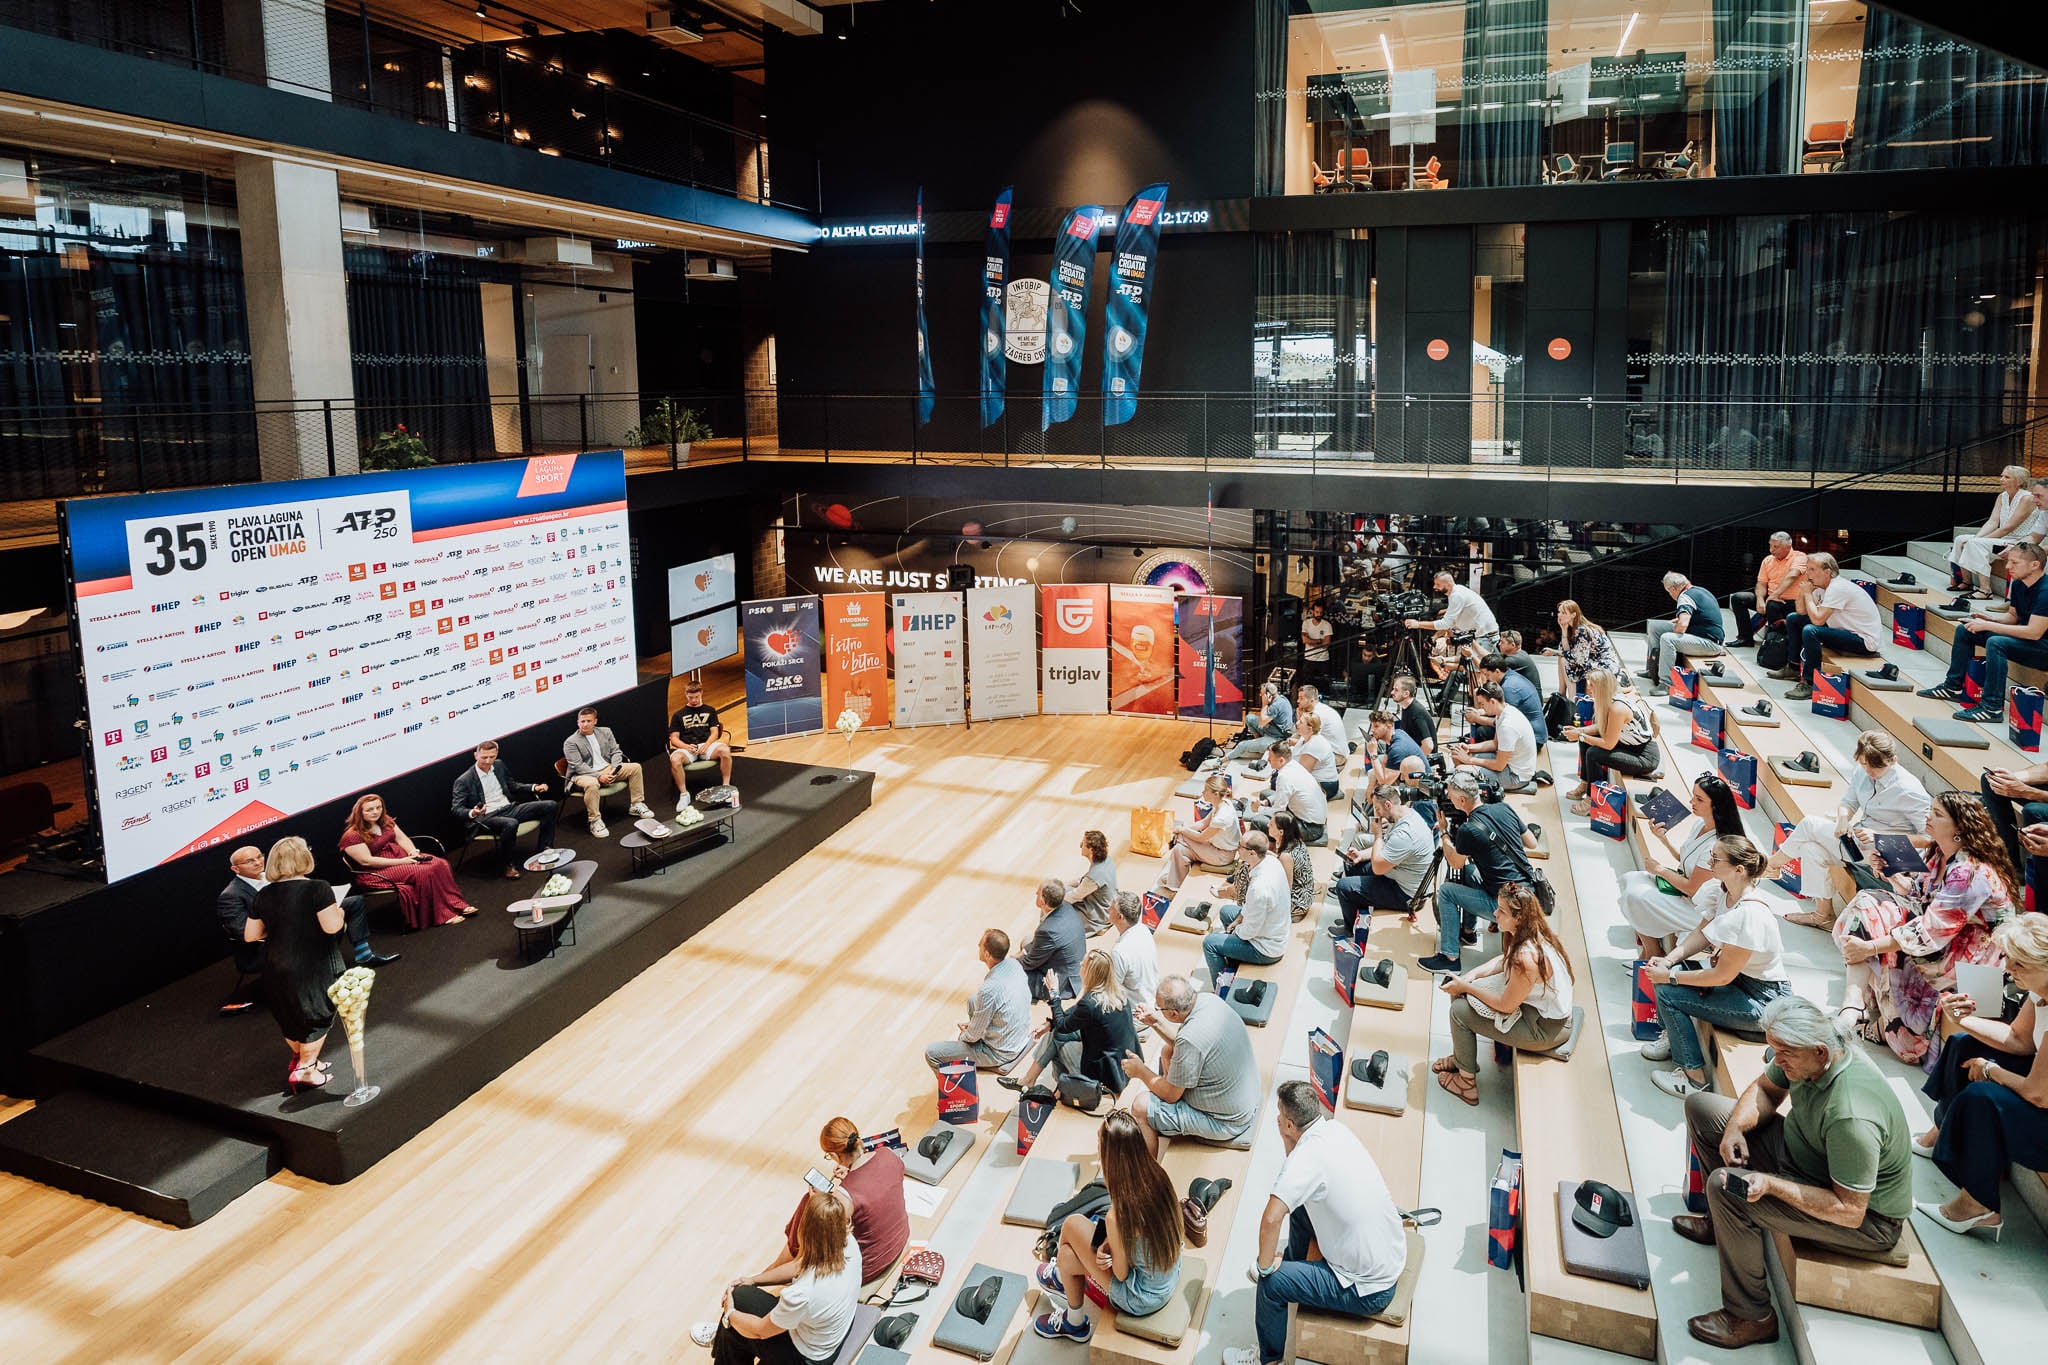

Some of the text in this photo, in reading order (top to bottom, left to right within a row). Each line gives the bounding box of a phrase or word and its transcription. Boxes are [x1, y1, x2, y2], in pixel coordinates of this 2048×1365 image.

[1158, 211, 1208, 224] 12:17:09
[832, 226, 866, 237] ALPHA
[1119, 259, 1146, 271] CROATIA
[1059, 266, 1085, 281] CROATIA
[1118, 268, 1130, 277] OPEN
[1012, 281, 1041, 292] INFOBIP
[1116, 284, 1142, 297] ATP
[1058, 289, 1082, 302] ATP
[1005, 346, 1032, 362] ZAGREB
[535, 473, 565, 483] SPORT
[228, 511, 303, 529] PLAVA LAGUNA
[331, 508, 396, 534] ATP
[229, 523, 304, 548] CROATIA
[373, 526, 397, 540] 250
[144, 522, 207, 576] 35
[232, 541, 306, 563] OPEN UMAG
[446, 550, 462, 558] ATP
[414, 556, 439, 564] Podravka
[298, 575, 318, 585] ATP
[442, 573, 465, 583] Podravka
[815, 566, 1027, 590] WE ARE JUST SRTING
[231, 589, 249, 598] triglav
[332, 595, 351, 604] ATP
[161, 601, 180, 611] HEP
[364, 613, 382, 622] ATP
[921, 614, 956, 630] HEP
[204, 621, 222, 632] HEP
[394, 630, 412, 640] ATP
[244, 641, 260, 651] HEP
[836, 638, 862, 654] sitno
[282, 659, 296, 669] HEP
[842, 656, 849, 670] i
[316, 676, 331, 686] HEP
[1049, 666, 1100, 684] triglav
[766, 676, 793, 688] PSK
[349, 692, 364, 702] HEP
[381, 708, 394, 718] HEP
[682, 713, 710, 726] EA7
[410, 722, 423, 732] HEP
[115, 782, 152, 799] REGENT
[162, 796, 197, 814] REGENT
